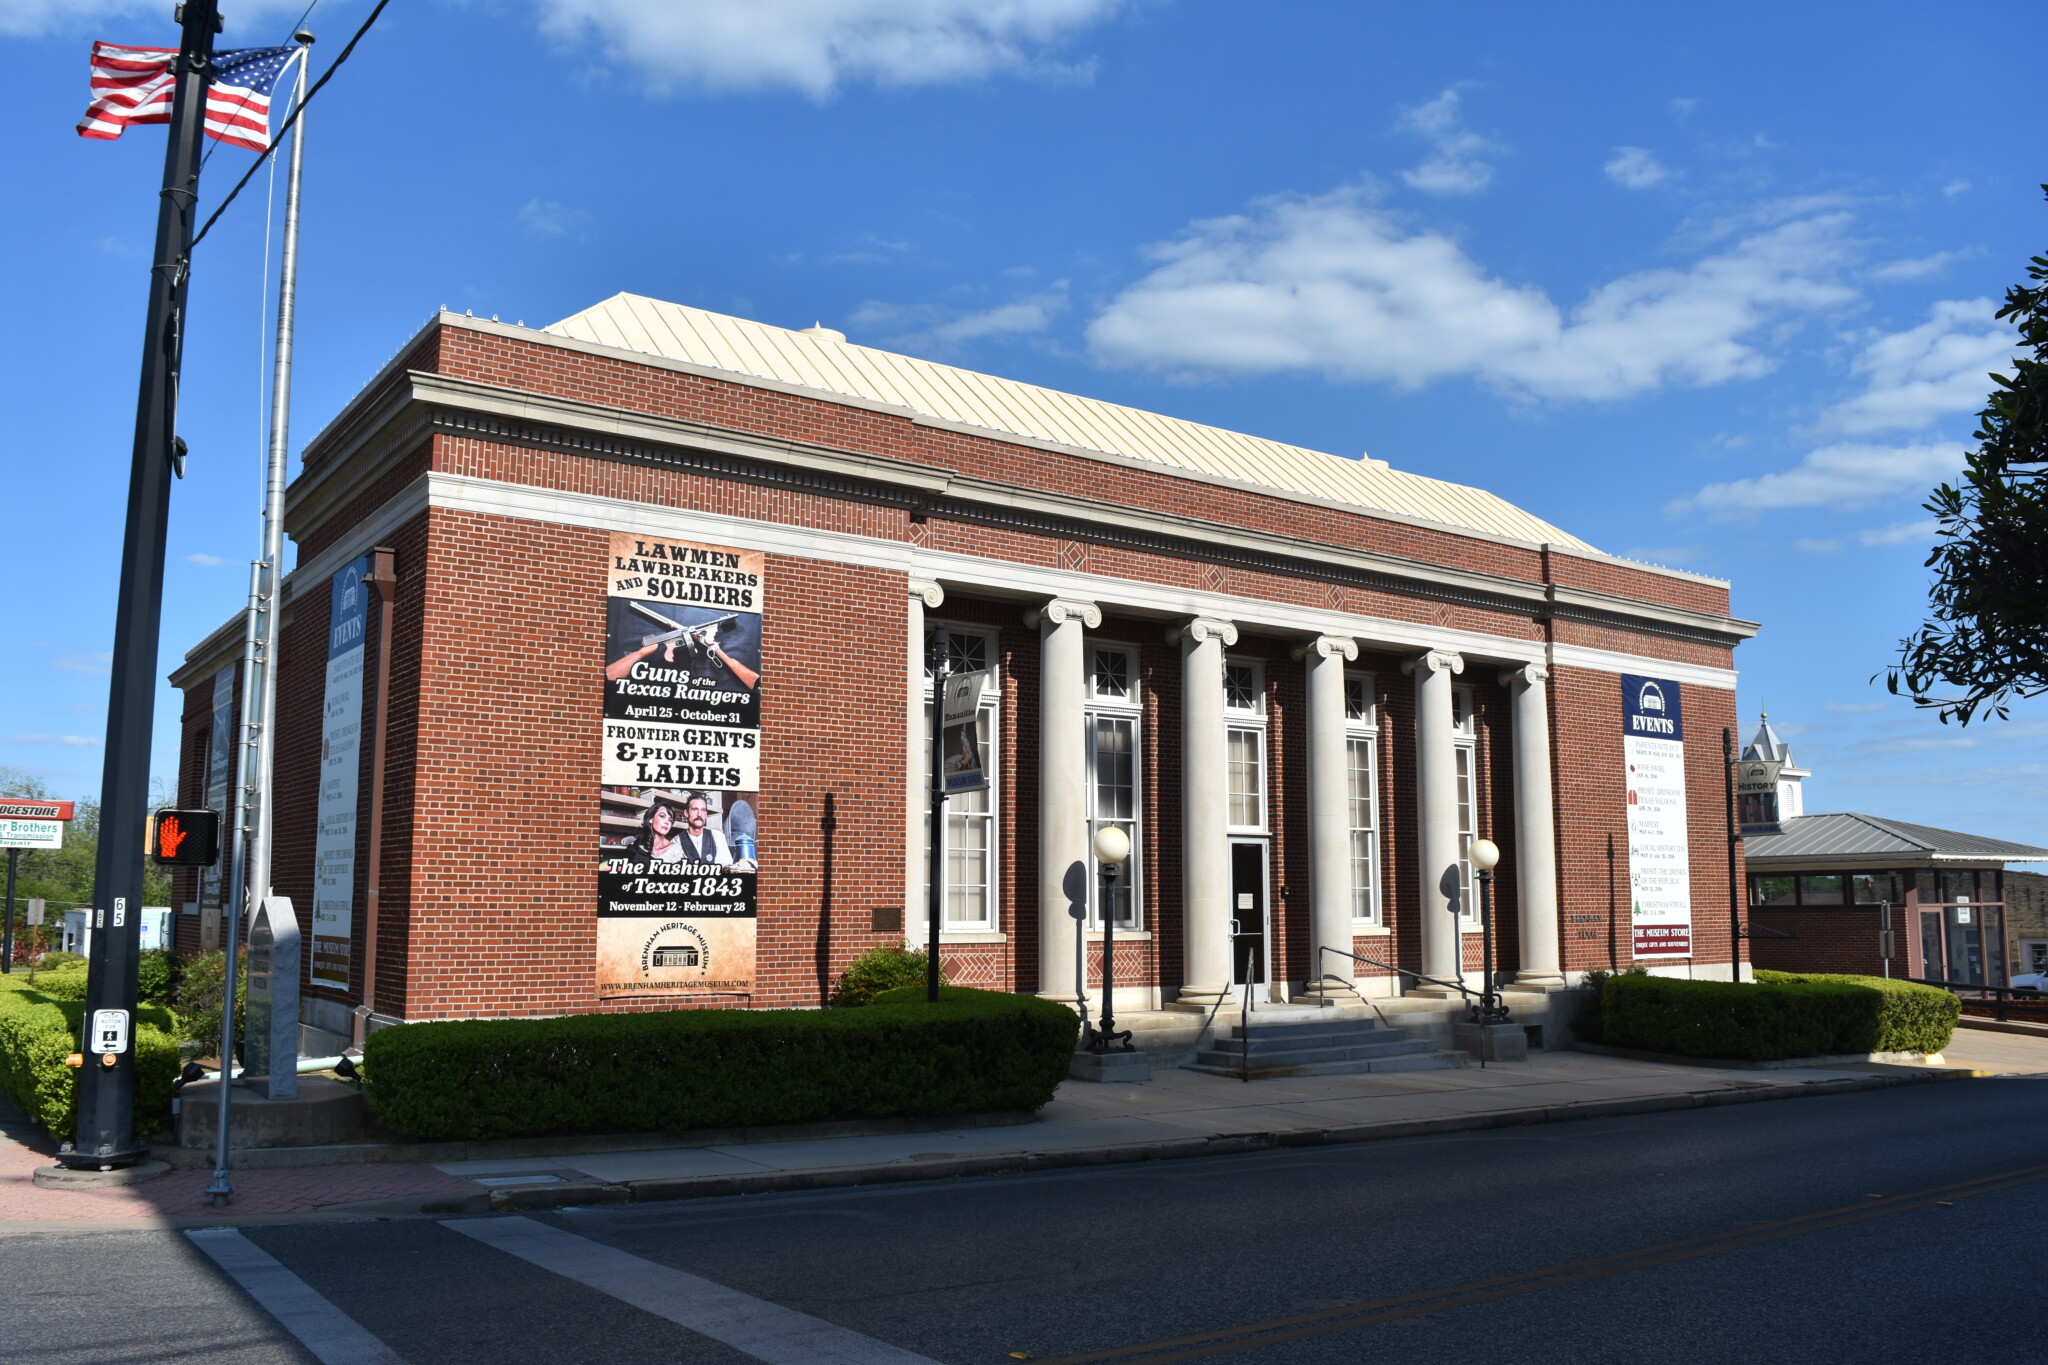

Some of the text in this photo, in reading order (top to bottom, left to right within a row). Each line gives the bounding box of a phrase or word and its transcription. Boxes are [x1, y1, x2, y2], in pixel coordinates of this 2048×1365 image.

[635, 540, 740, 569] LAWMEN
[615, 556, 758, 587] LAWBREAKERS
[616, 577, 753, 608] AND SOLDIERS
[333, 614, 362, 648] EVENTS
[631, 661, 716, 687] Guns of the
[616, 678, 750, 705] Texas Rangers
[625, 704, 657, 718] April
[658, 707, 673, 718] 25
[680, 708, 727, 723] October
[728, 712, 741, 724] 31
[1632, 715, 1674, 734] EVENTS
[606, 725, 756, 748] FRONTIER GENTS
[615, 742, 729, 764] & PIONEER
[636, 763, 741, 787] LADIES
[1738, 782, 1775, 790] HISTORY
[6, 831, 54, 839] Transmission
[11, 821, 58, 833] Brothers
[609, 858, 721, 876] The Fashion
[621, 878, 743, 897] of Texas 1843
[609, 901, 664, 911] November
[665, 902, 677, 911] 12
[683, 901, 732, 913] February
[733, 902, 745, 911] 28
[1634, 928, 1690, 938] THE MUSEUM STORE
[642, 922, 709, 971] BRENHAM HERITAGE MUSEUM
[600, 980, 749, 991] WWW.BRENHAMHERITAGEMUSEUM.COM
